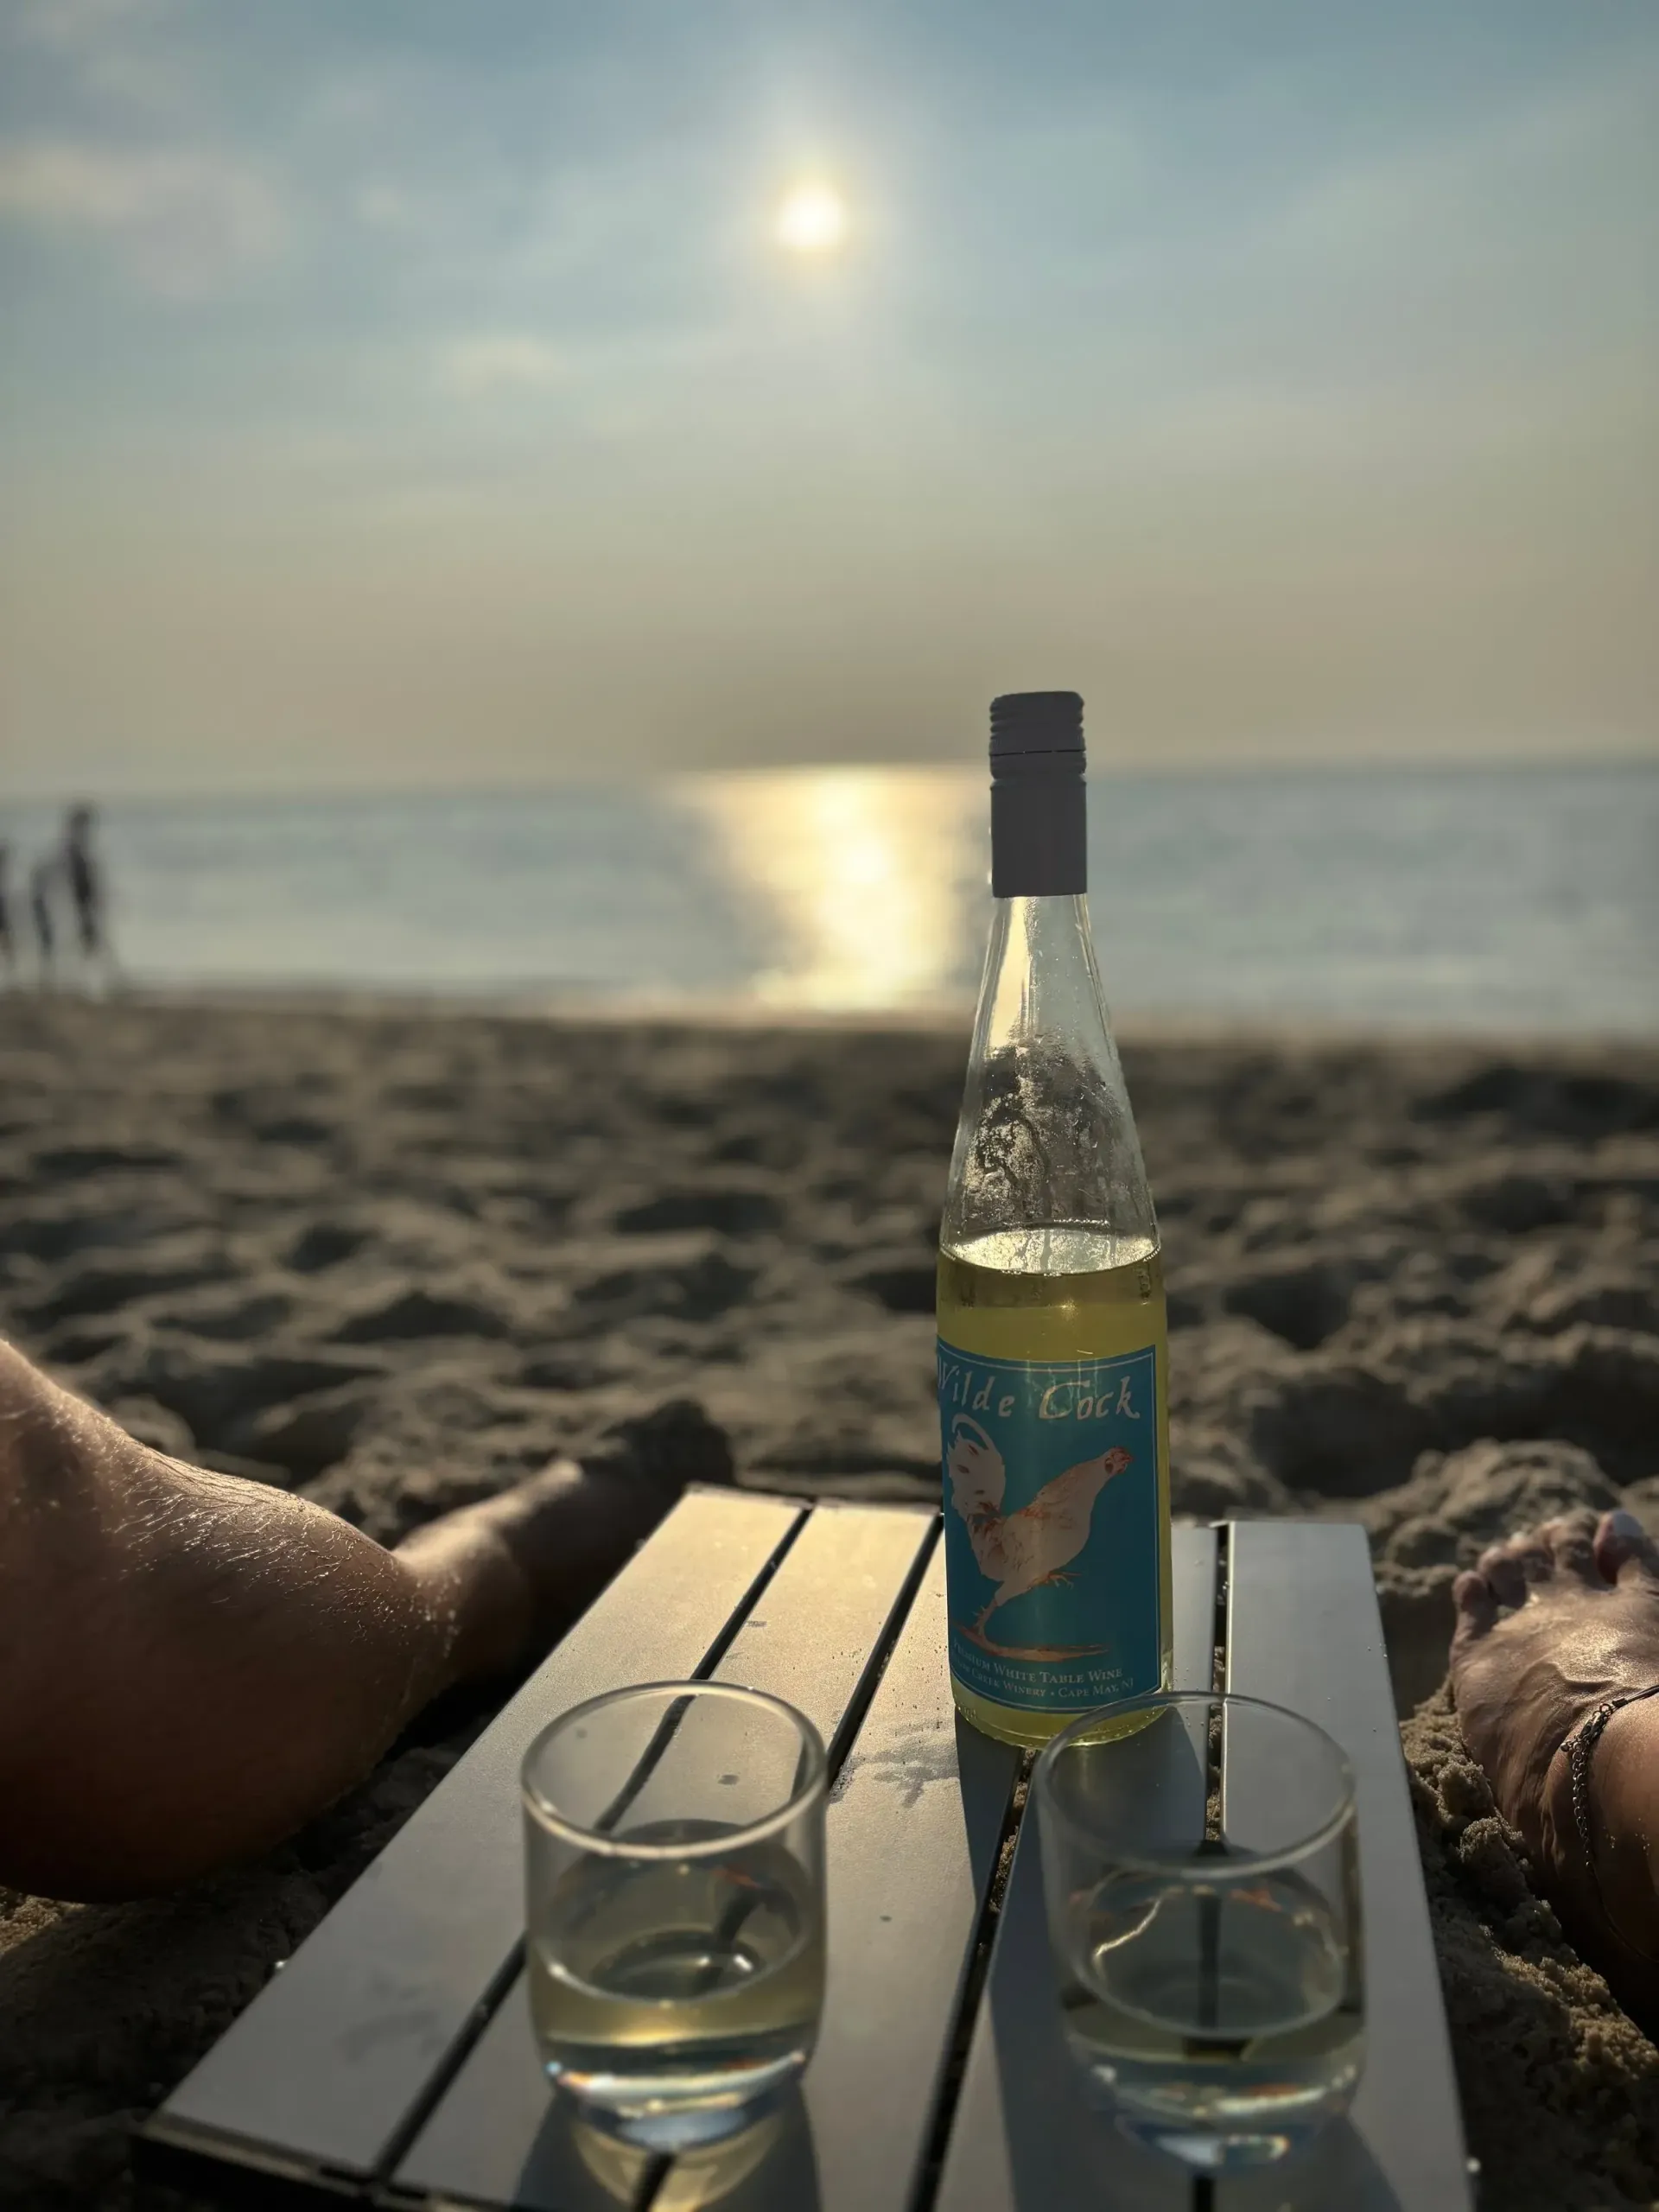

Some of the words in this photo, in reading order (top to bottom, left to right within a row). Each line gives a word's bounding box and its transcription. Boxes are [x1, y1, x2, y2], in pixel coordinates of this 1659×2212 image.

[1039, 1376, 1141, 1421] Cock
[994, 1662, 1037, 1683] WHITE
[1039, 1671, 1085, 1684] TABLE
[1089, 1668, 1123, 1682] WINE
[1002, 1680, 1046, 1698] WINERY
[1058, 1687, 1090, 1698] CAPE
[1092, 1683, 1120, 1696] MAY,
